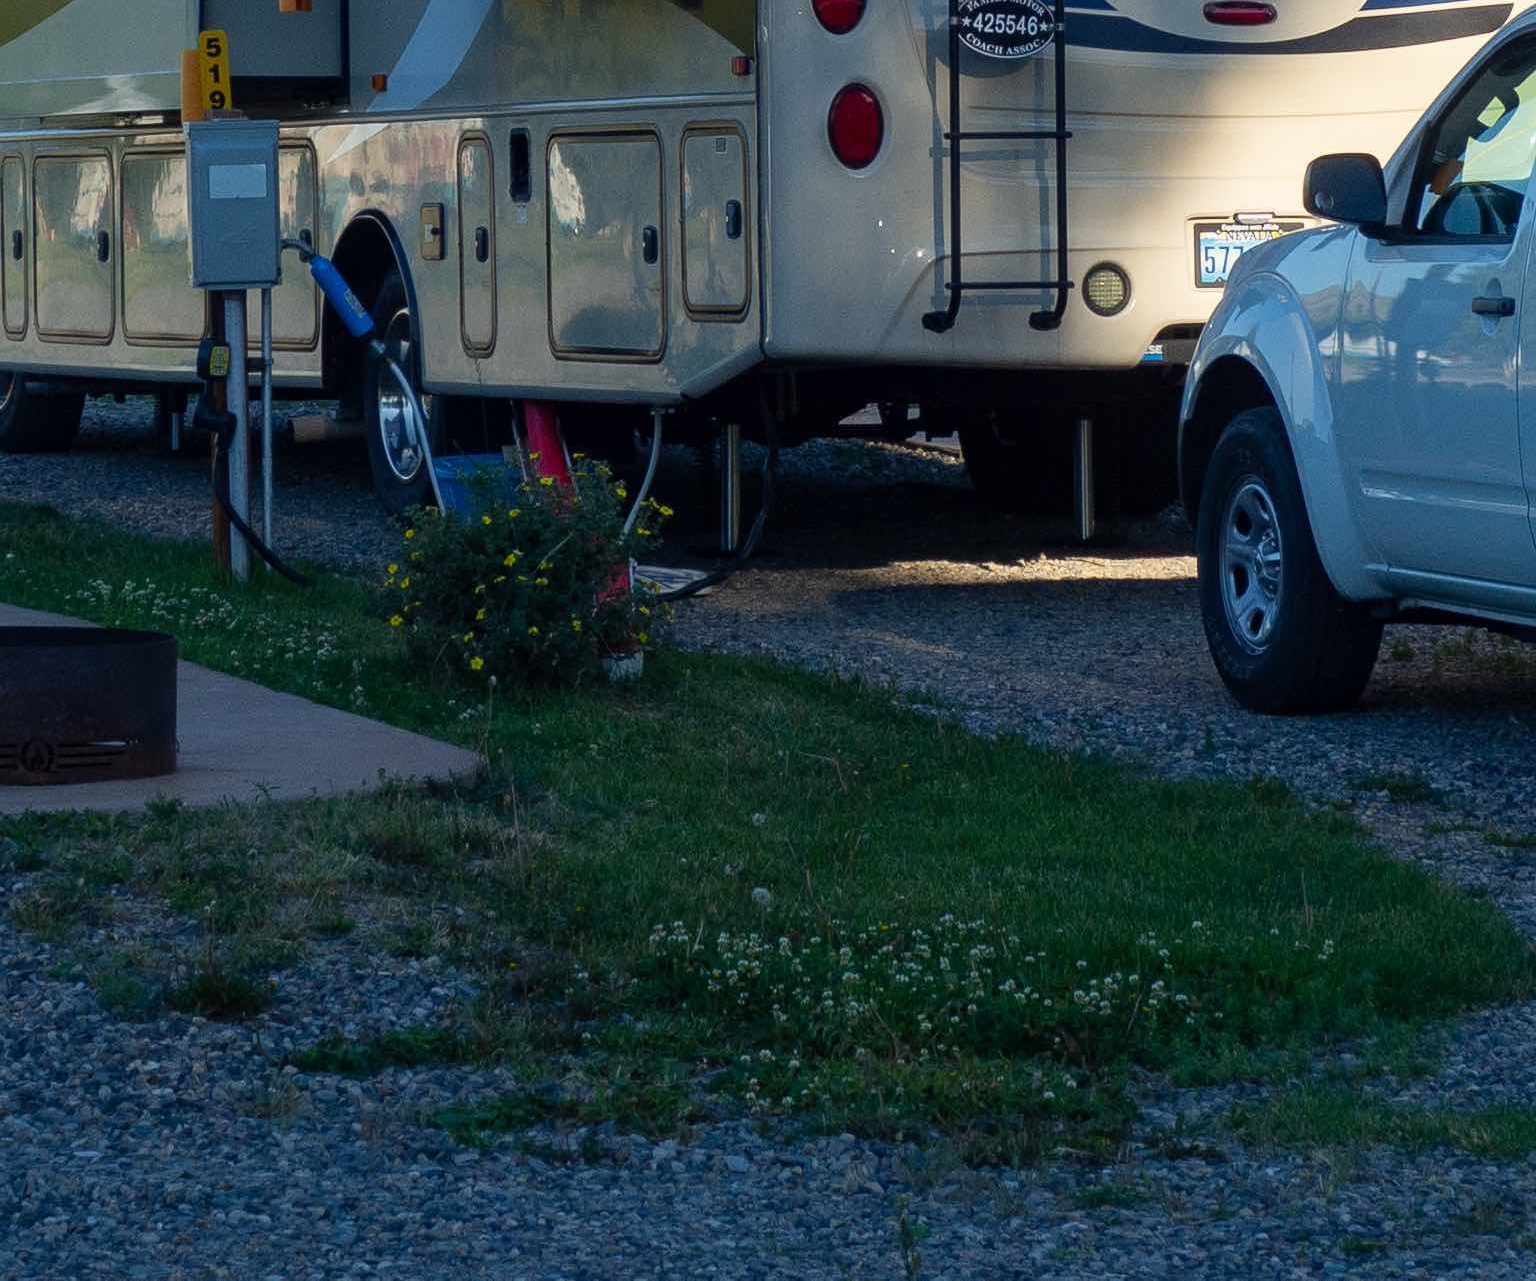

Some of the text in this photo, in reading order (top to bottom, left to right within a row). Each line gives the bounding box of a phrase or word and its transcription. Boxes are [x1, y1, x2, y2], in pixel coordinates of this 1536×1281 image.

[972, 12, 1038, 36] 425546
[965, 32, 1045, 55] COACH ASSOC.
[206, 36, 227, 109] 519
